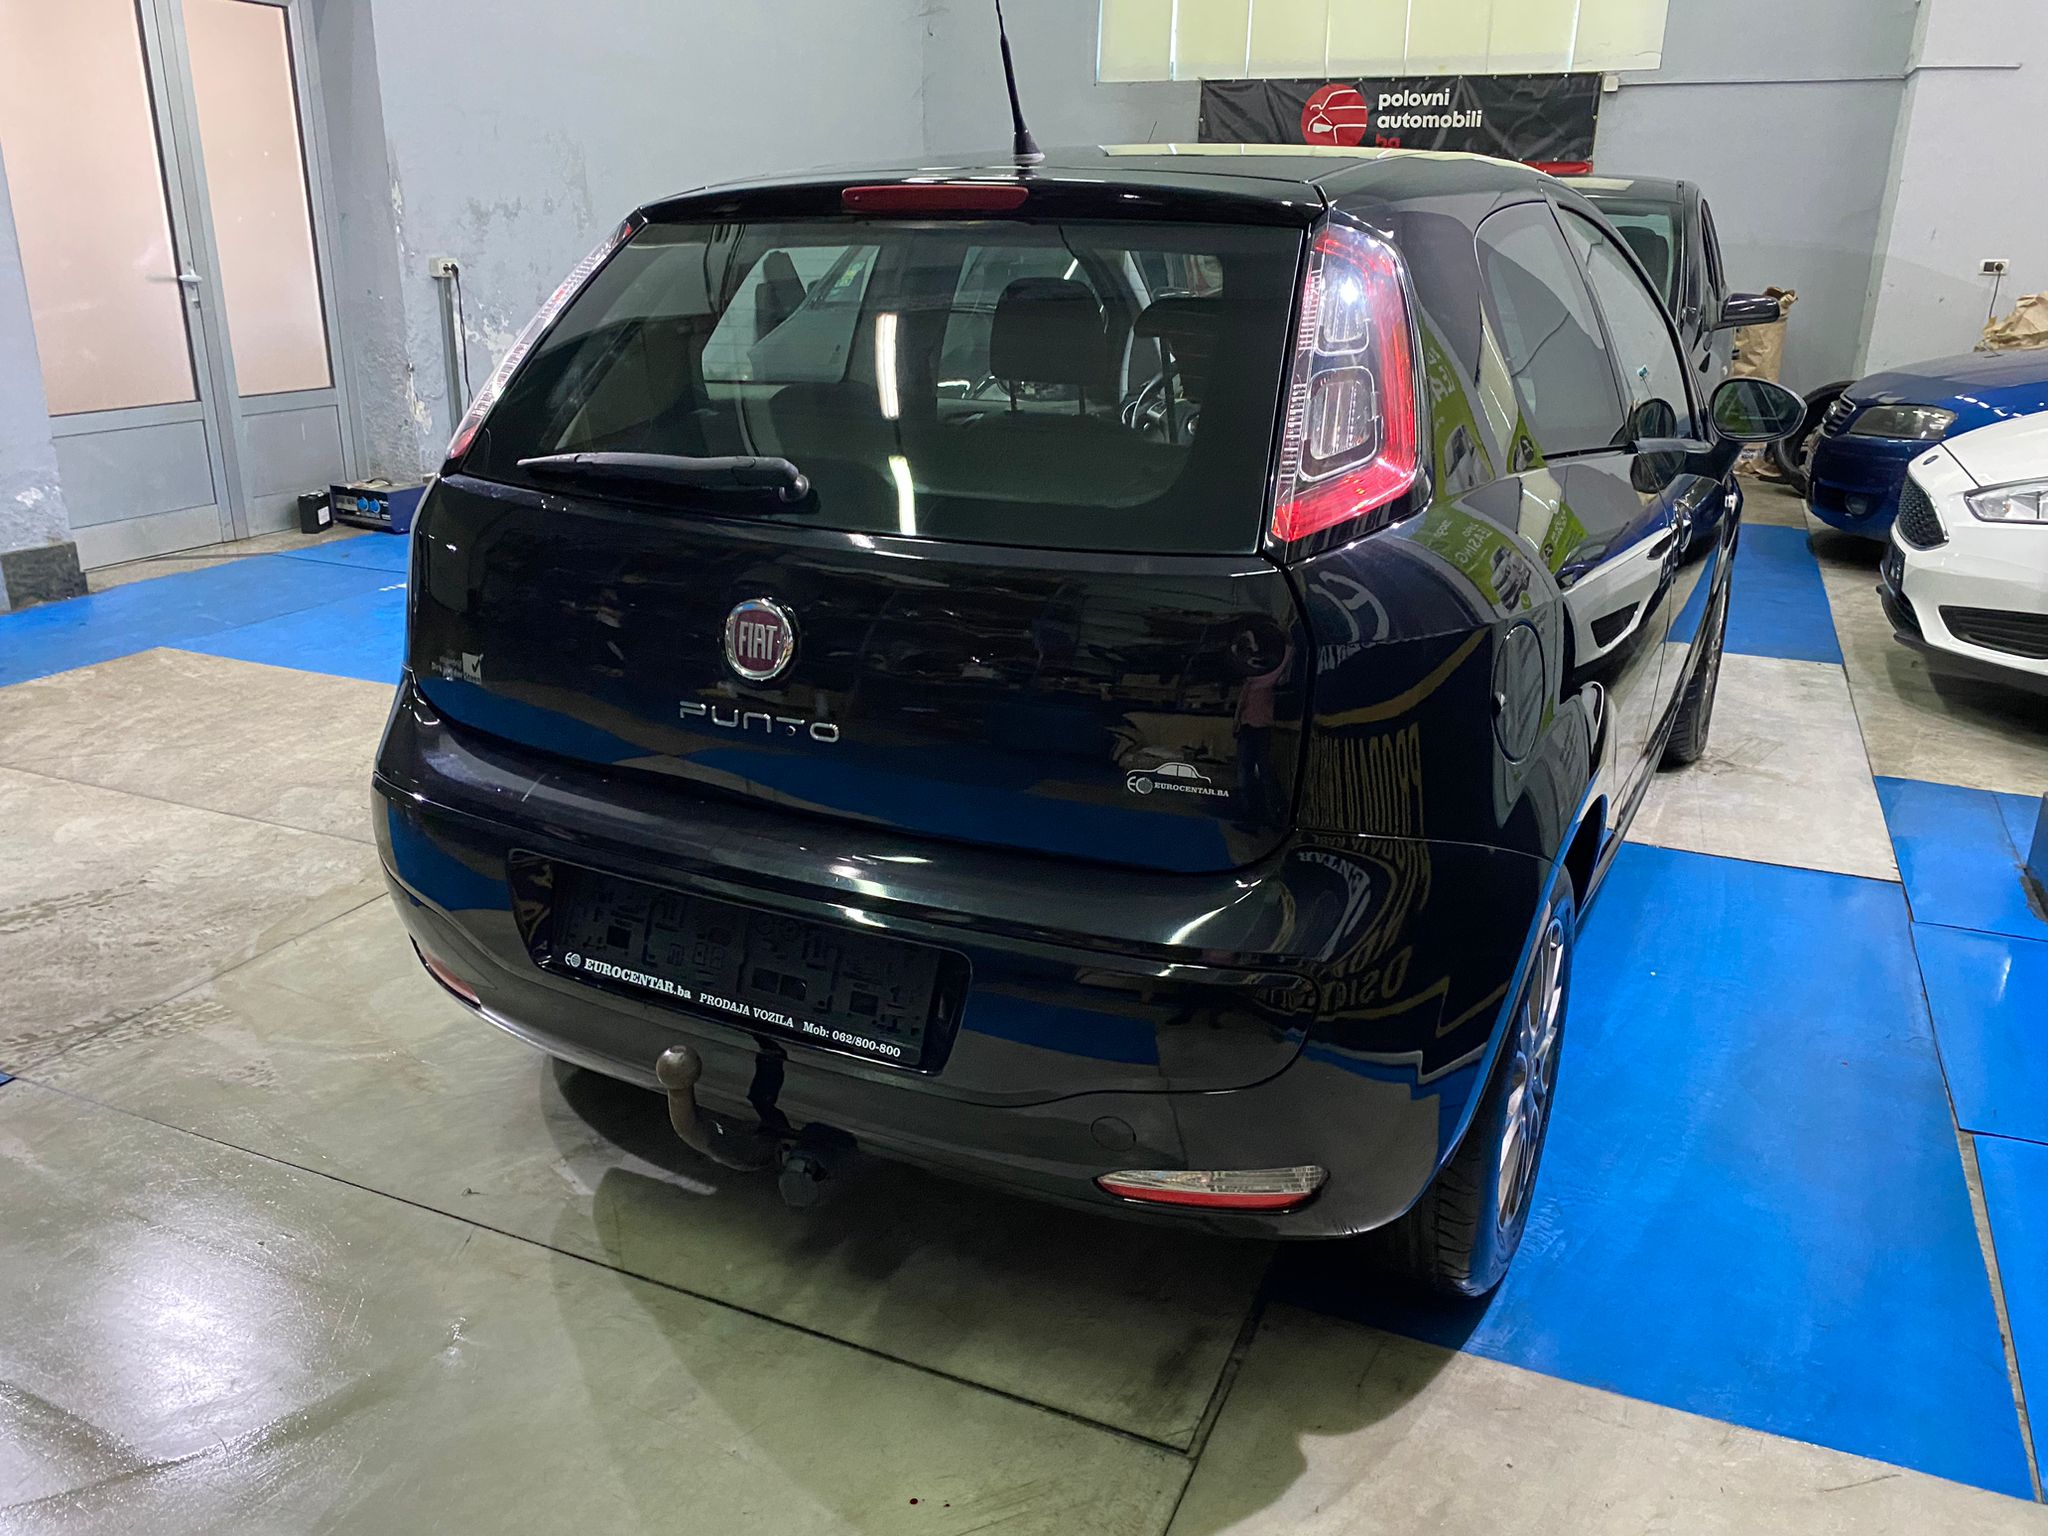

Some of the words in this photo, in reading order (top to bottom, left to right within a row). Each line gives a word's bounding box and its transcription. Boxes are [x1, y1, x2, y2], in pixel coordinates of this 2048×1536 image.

[1378, 88, 1450, 110] polovni
[1377, 110, 1482, 128] automobili
[738, 621, 778, 661] FIAT
[679, 701, 840, 743] PUNTO
[1154, 781, 1229, 797] EUROCENTAR.BA
[584, 958, 692, 999] EUROCENTAR.ba
[699, 993, 750, 1016] PRODAJA
[753, 1007, 795, 1028] VOZILA
[802, 1021, 830, 1038] Mob:
[832, 1030, 901, 1058] 062/800-800
